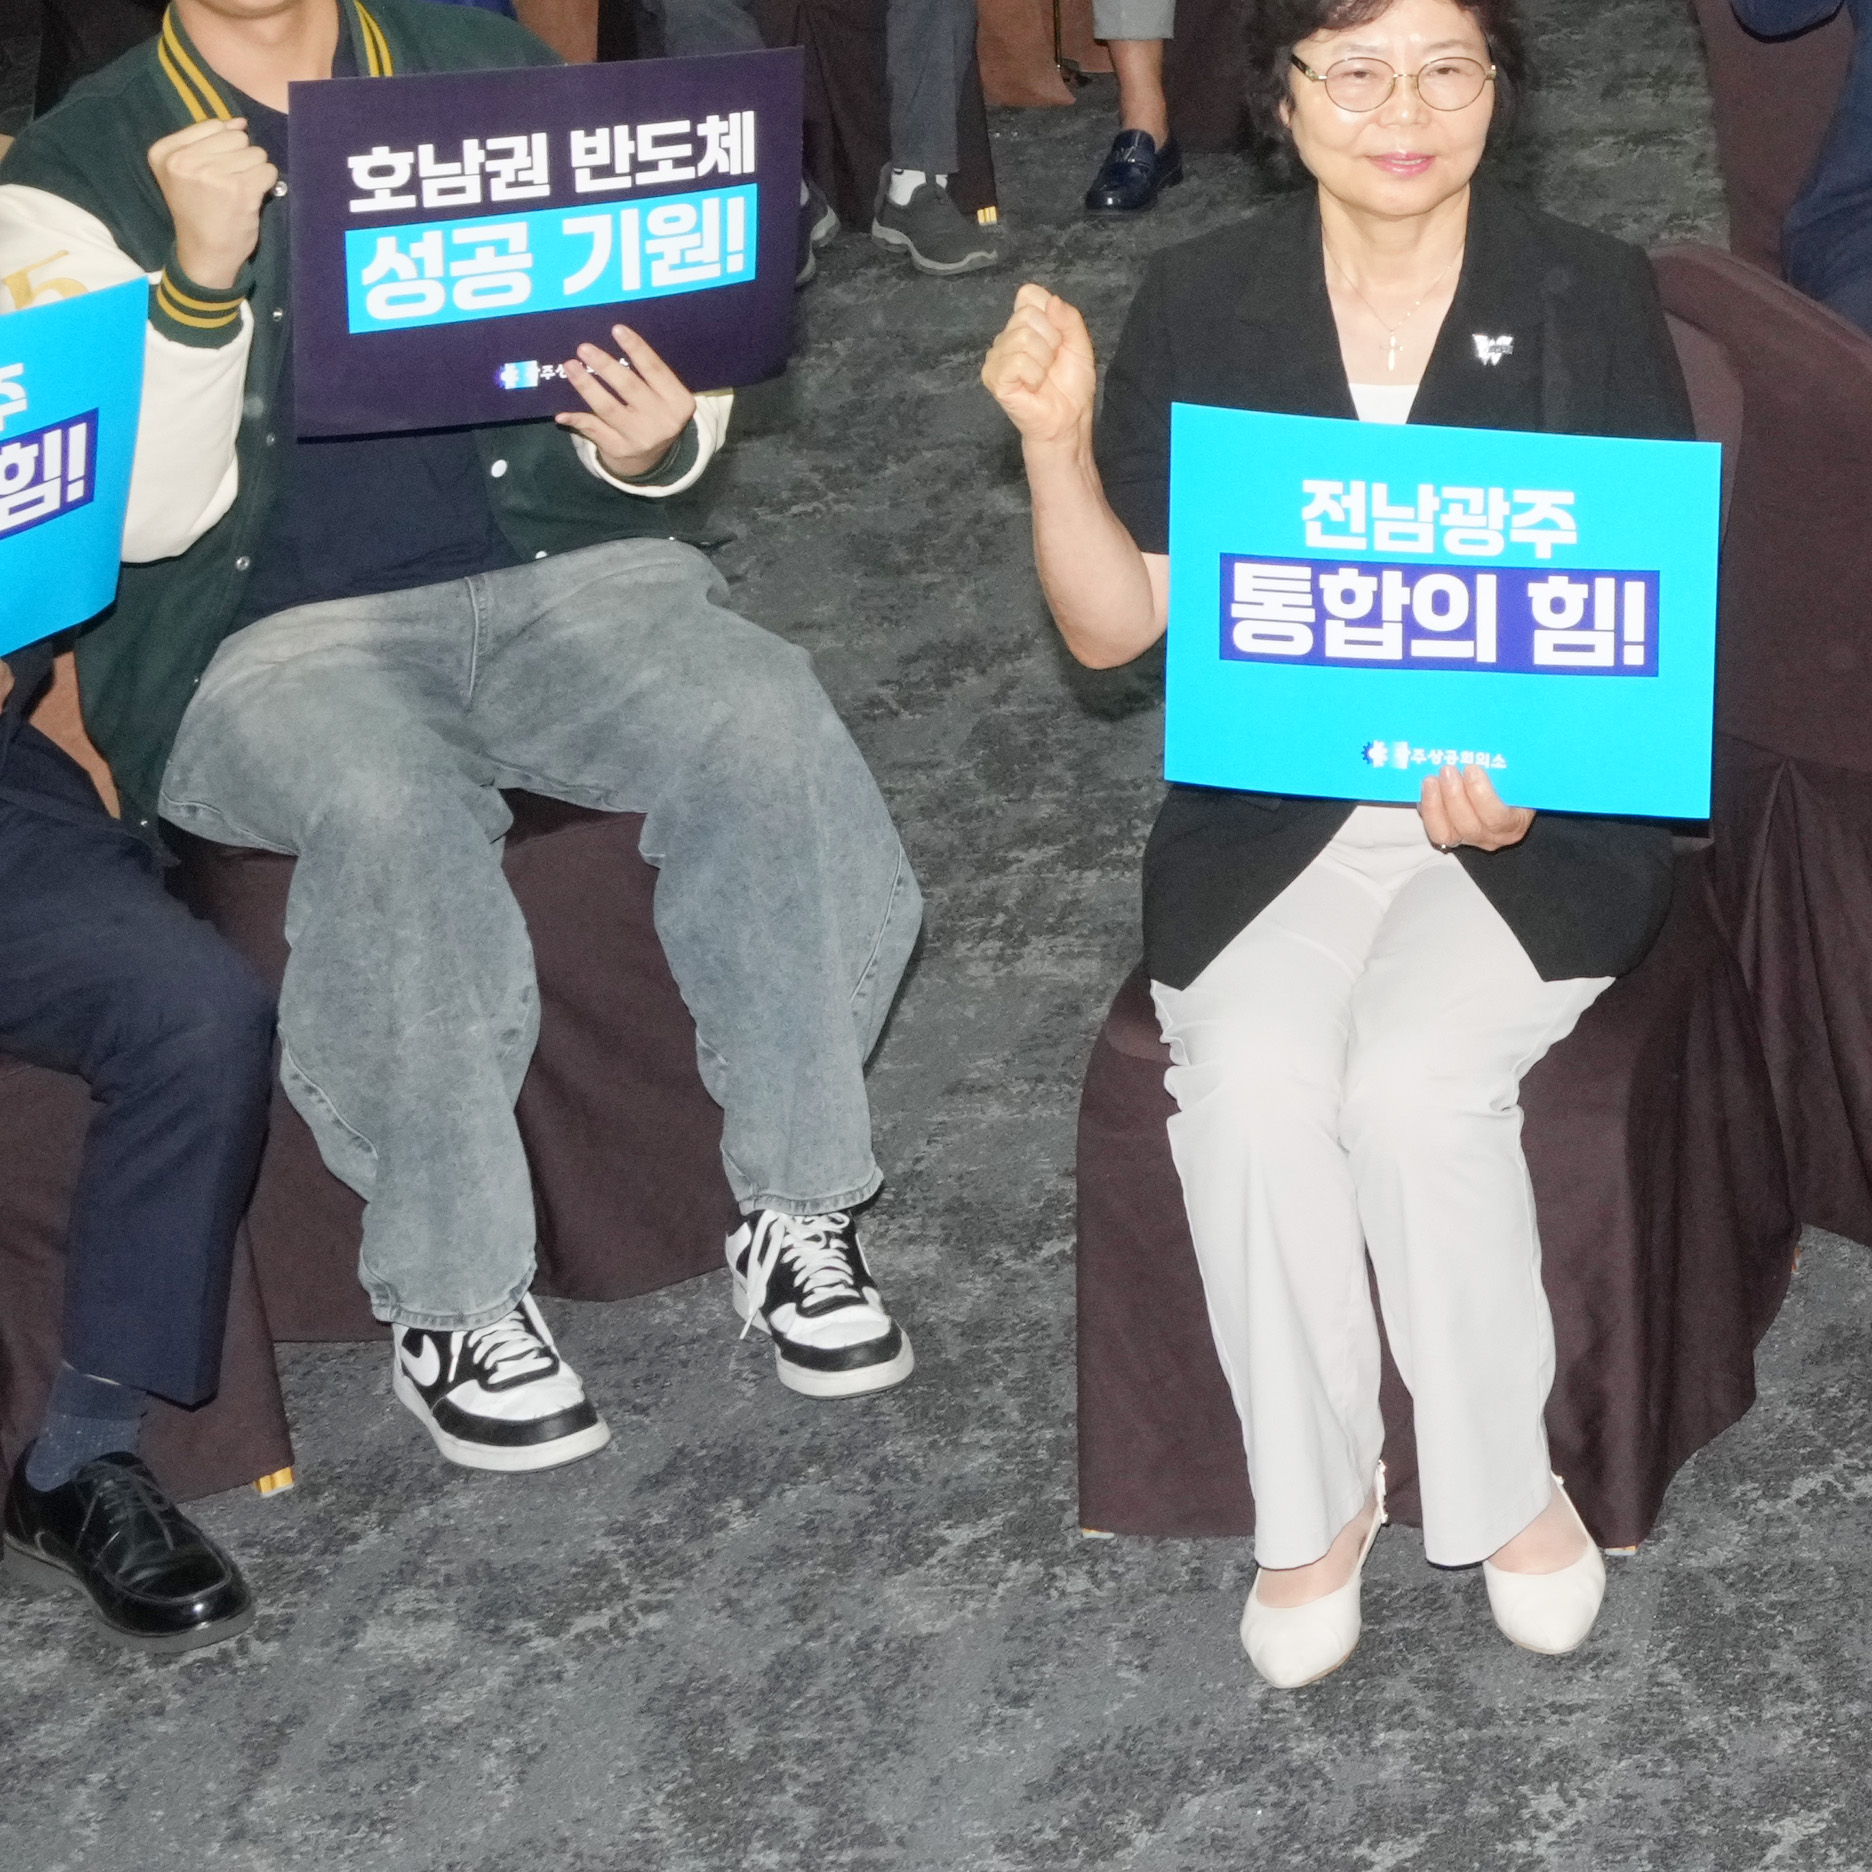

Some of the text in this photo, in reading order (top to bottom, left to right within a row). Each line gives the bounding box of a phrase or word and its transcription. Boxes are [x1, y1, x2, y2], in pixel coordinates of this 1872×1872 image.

[347, 110, 755, 213] 호남권 반도체
[361, 196, 746, 321] 성공 기원!
[1301, 479, 1578, 559] 전남광주
[1230, 562, 1646, 667] 통합의 힘!
